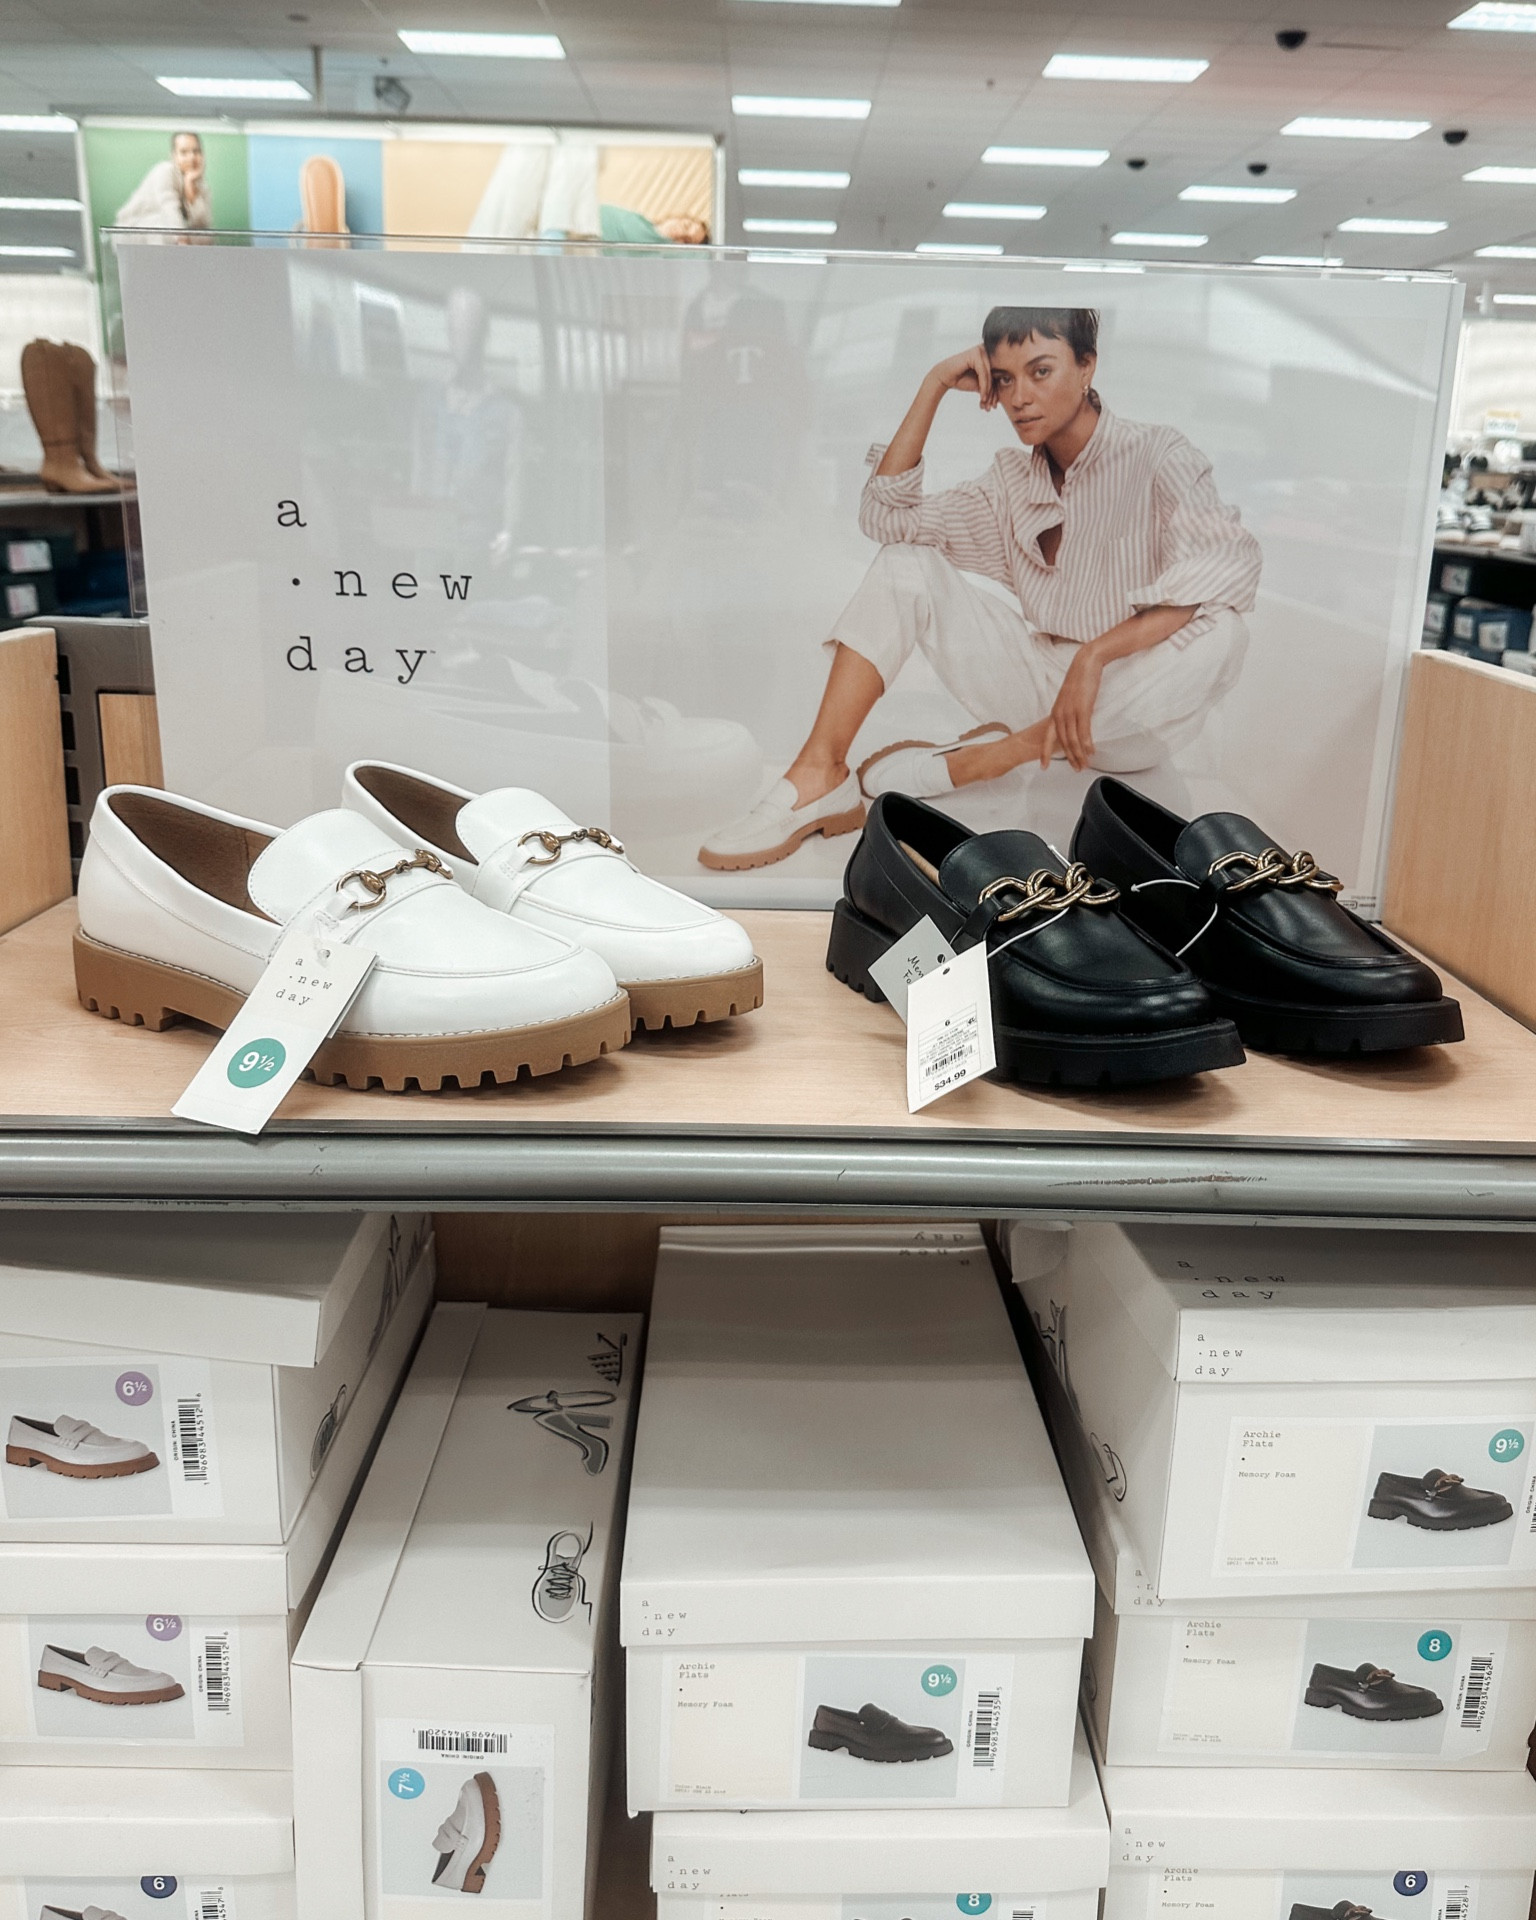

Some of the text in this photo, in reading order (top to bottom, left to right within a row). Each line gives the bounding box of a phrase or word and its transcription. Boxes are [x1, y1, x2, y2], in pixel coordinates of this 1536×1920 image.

[277, 499, 308, 528] a
[294, 956, 305, 967] a
[933, 1068, 967, 1092] $34.99
[1176, 1260, 1194, 1269] a
[1196, 1333, 1205, 1342] a
[1242, 1430, 1282, 1439] Archie
[1242, 1439, 1274, 1448] Flats
[1237, 1470, 1297, 1480] Memory Foam
[1134, 1569, 1143, 1577] a
[641, 1599, 650, 1608] a
[1133, 1596, 1166, 1608] day
[1186, 1620, 1222, 1629] Archie
[1186, 1628, 1216, 1637] Flats
[1428, 1637, 1441, 1653] 8
[678, 1662, 716, 1671] Archie
[678, 1671, 710, 1679] Flats
[677, 1700, 709, 1709] Memory
[1124, 1827, 1132, 1835] a
[667, 1854, 675, 1863] a
[152, 1876, 167, 1891] 6
[1404, 1874, 1417, 1889] 6
[968, 1893, 980, 1907] 8
